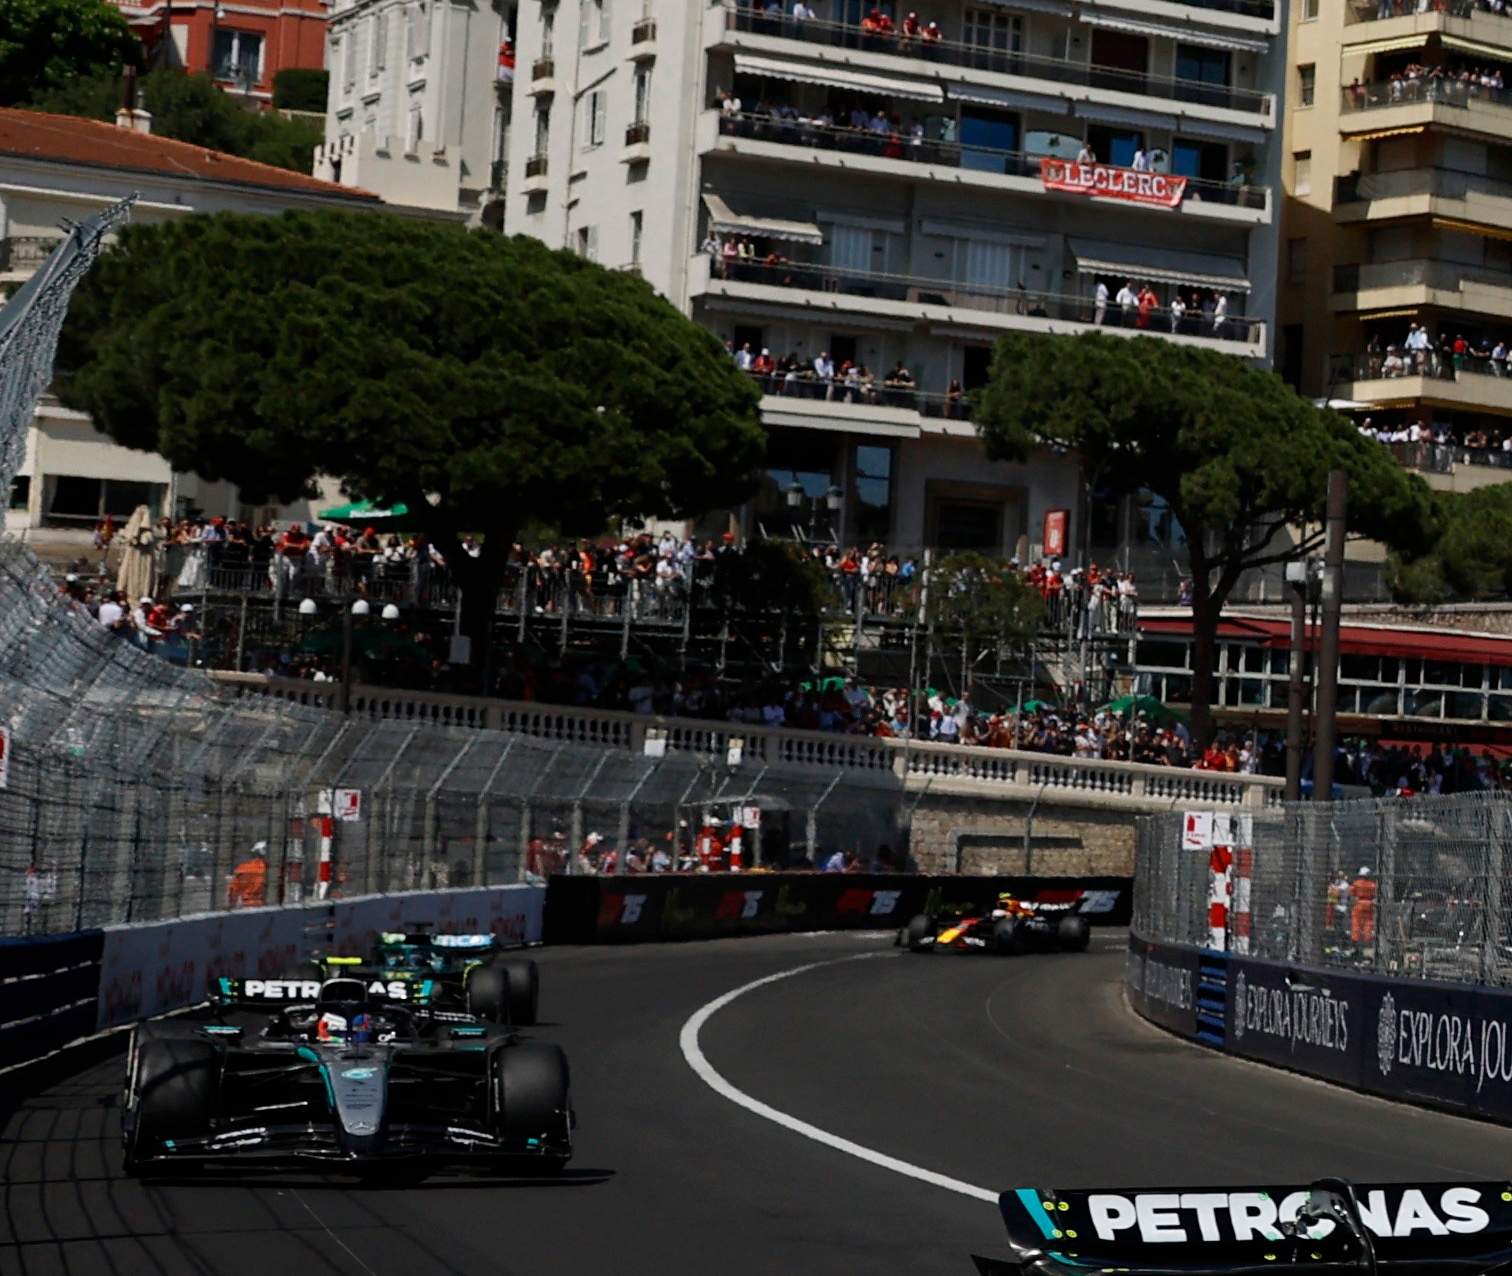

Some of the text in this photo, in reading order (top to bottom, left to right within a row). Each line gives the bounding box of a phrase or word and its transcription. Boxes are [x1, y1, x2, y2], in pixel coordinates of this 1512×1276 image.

[1064, 163, 1166, 197] LECLERC
[245, 979, 408, 1001] PETRAS
[1246, 983, 1291, 1038] EXPLORA
[1399, 1009, 1475, 1076] EXPLORA
